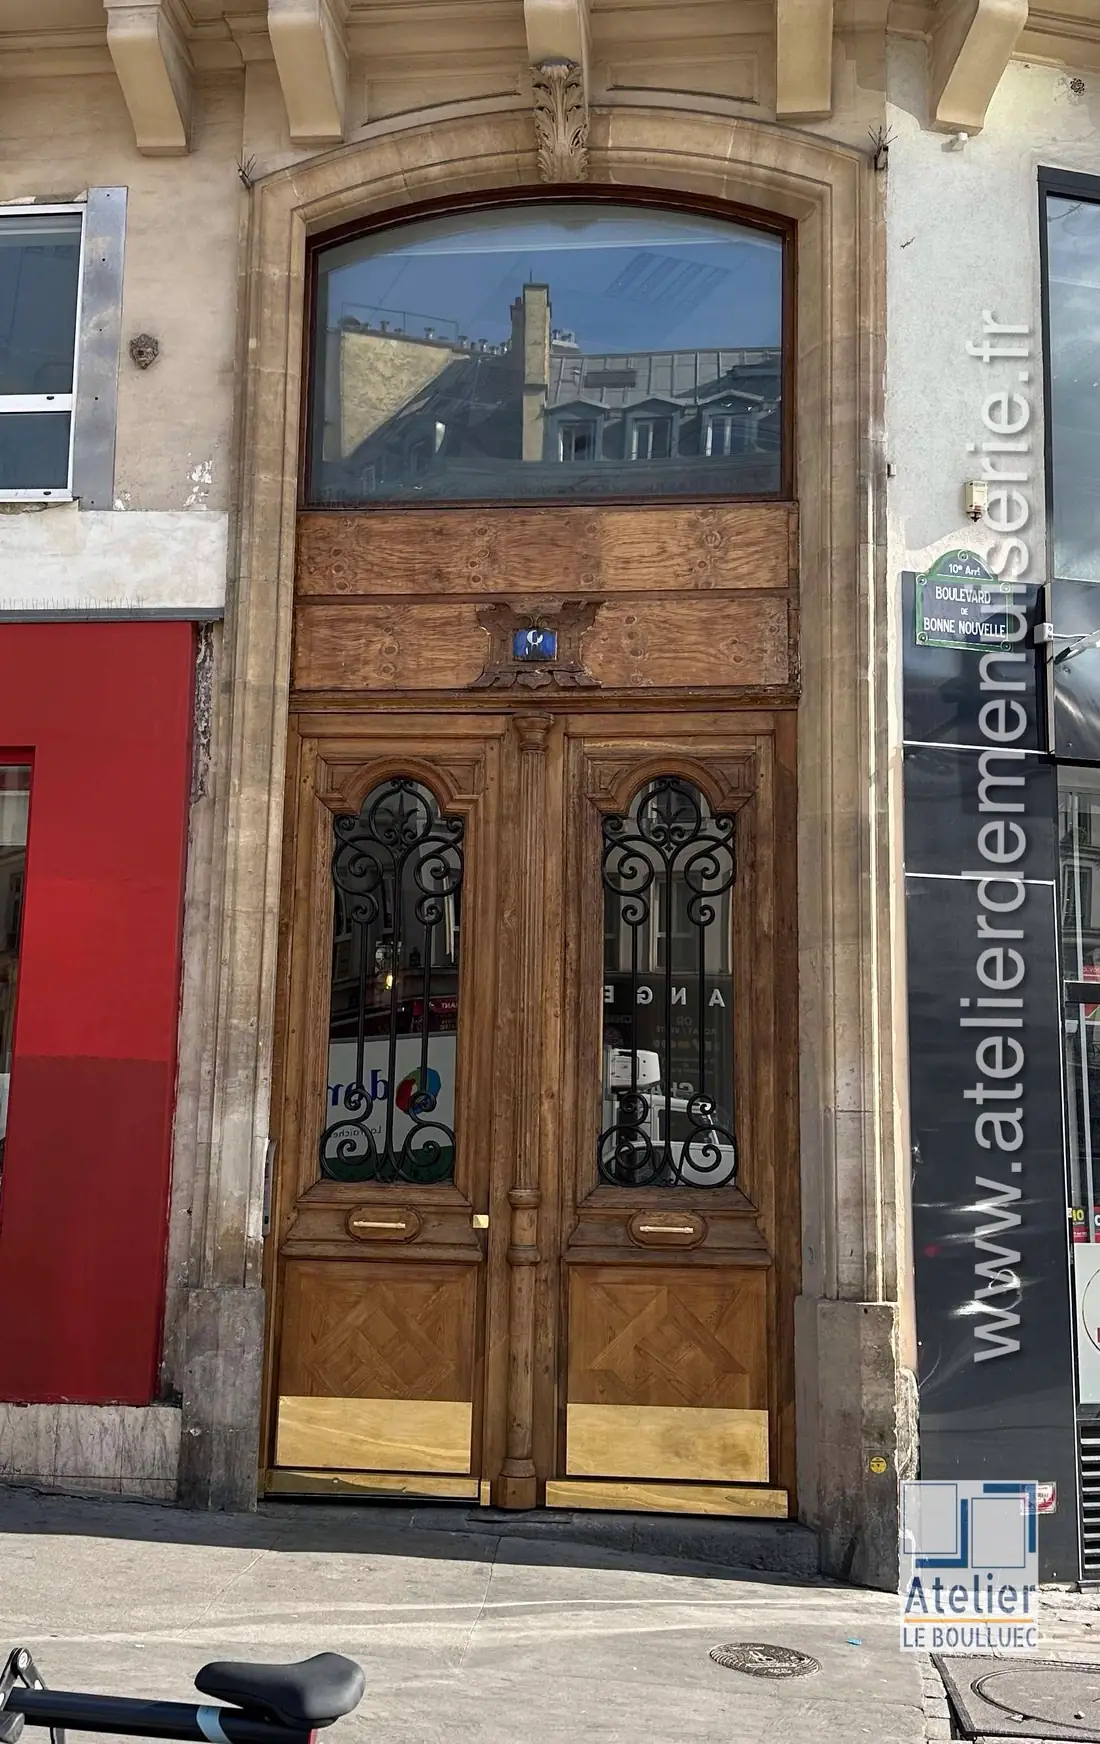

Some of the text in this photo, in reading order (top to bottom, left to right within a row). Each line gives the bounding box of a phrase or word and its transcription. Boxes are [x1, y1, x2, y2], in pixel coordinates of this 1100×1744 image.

[935, 586, 991, 605] BOULEVARD
[960, 607, 968, 616] DE
[923, 617, 1006, 638] BONNE NOUVELLE
